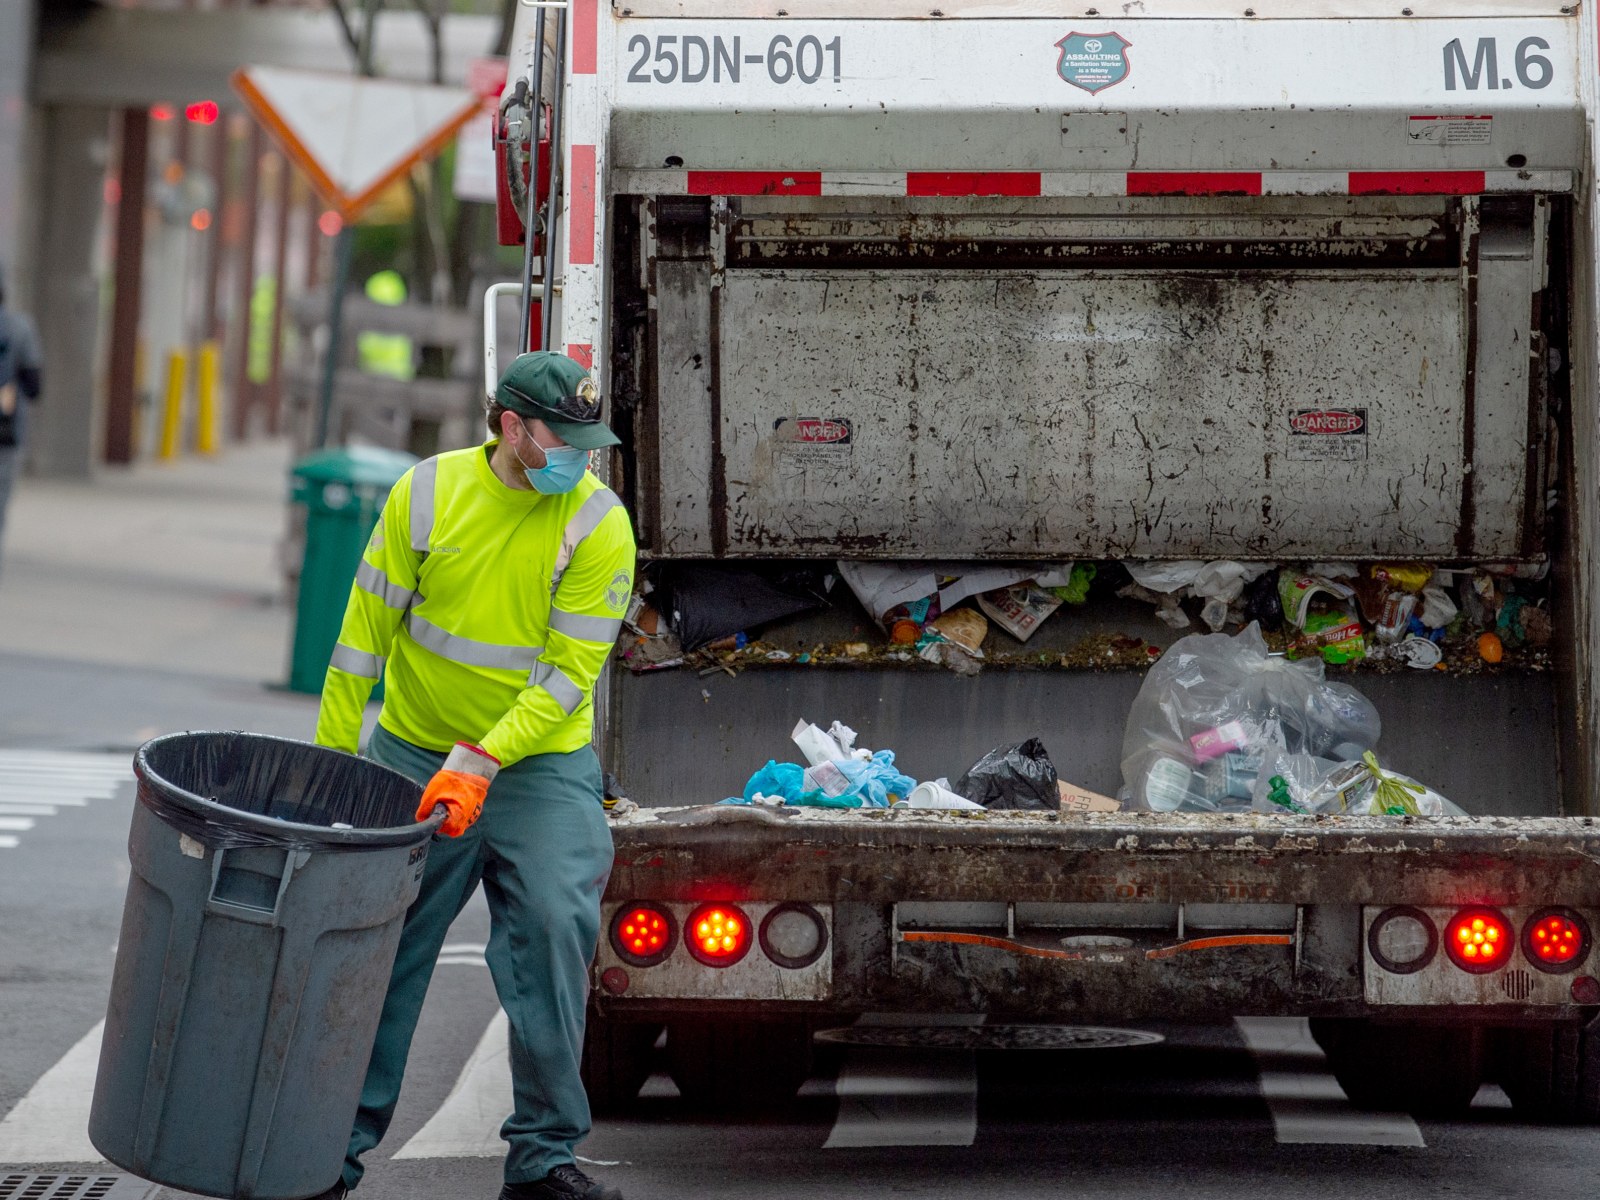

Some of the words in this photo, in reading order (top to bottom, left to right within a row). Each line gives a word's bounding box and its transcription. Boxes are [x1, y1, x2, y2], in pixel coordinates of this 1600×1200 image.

[627, 34, 843, 85] 25DN-601
[1442, 36, 1554, 91] M.6
[1297, 416, 1357, 429] DANGER
[797, 425, 842, 438] NGER
[1075, 795, 1092, 811] FR
